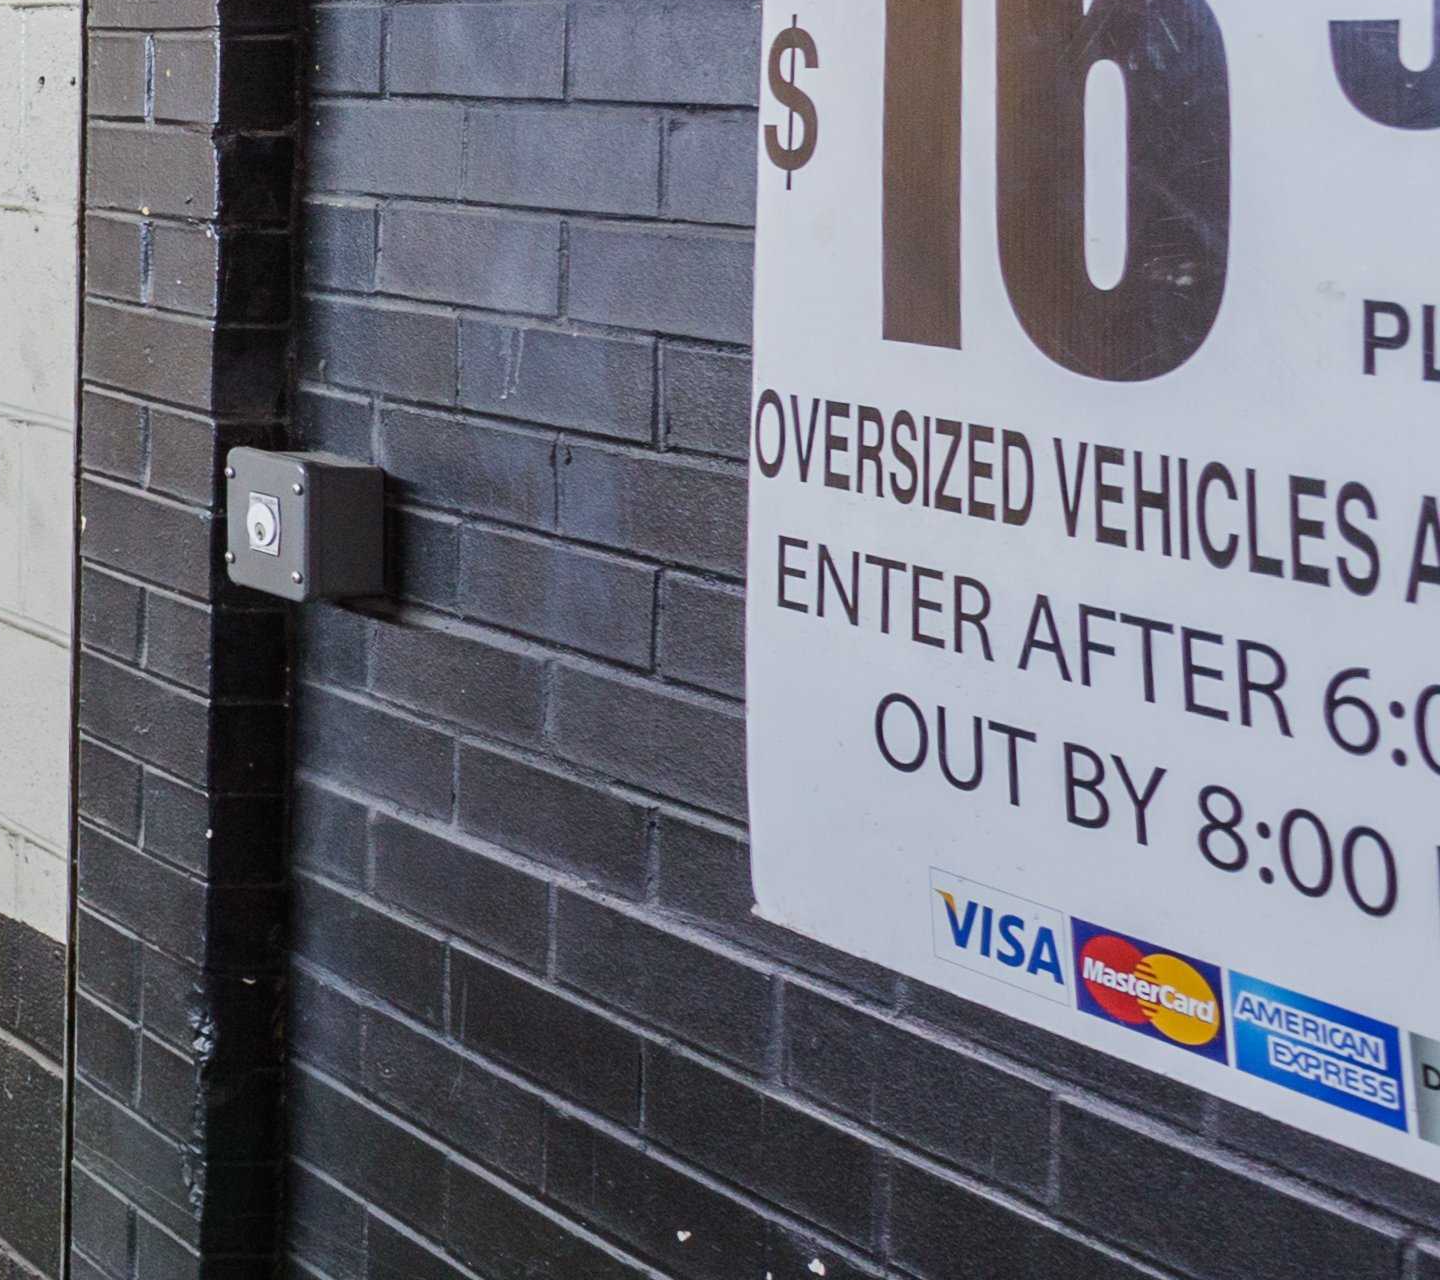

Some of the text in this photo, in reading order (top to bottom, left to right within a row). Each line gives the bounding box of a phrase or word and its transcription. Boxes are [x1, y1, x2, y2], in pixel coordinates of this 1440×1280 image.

[755, 388, 1034, 526] OVERSIZED
[1053, 438, 1379, 597] VEHICLES
[777, 534, 994, 663] ENTER
[1018, 595, 1294, 738] AFTER
[875, 692, 1398, 918] OUT BY 8:00
[934, 888, 1065, 985] VISA
[1083, 956, 1214, 1024] MasterCard
[1233, 994, 1385, 1069] AMERICAN
[1271, 1041, 1398, 1108] EXPRESS
